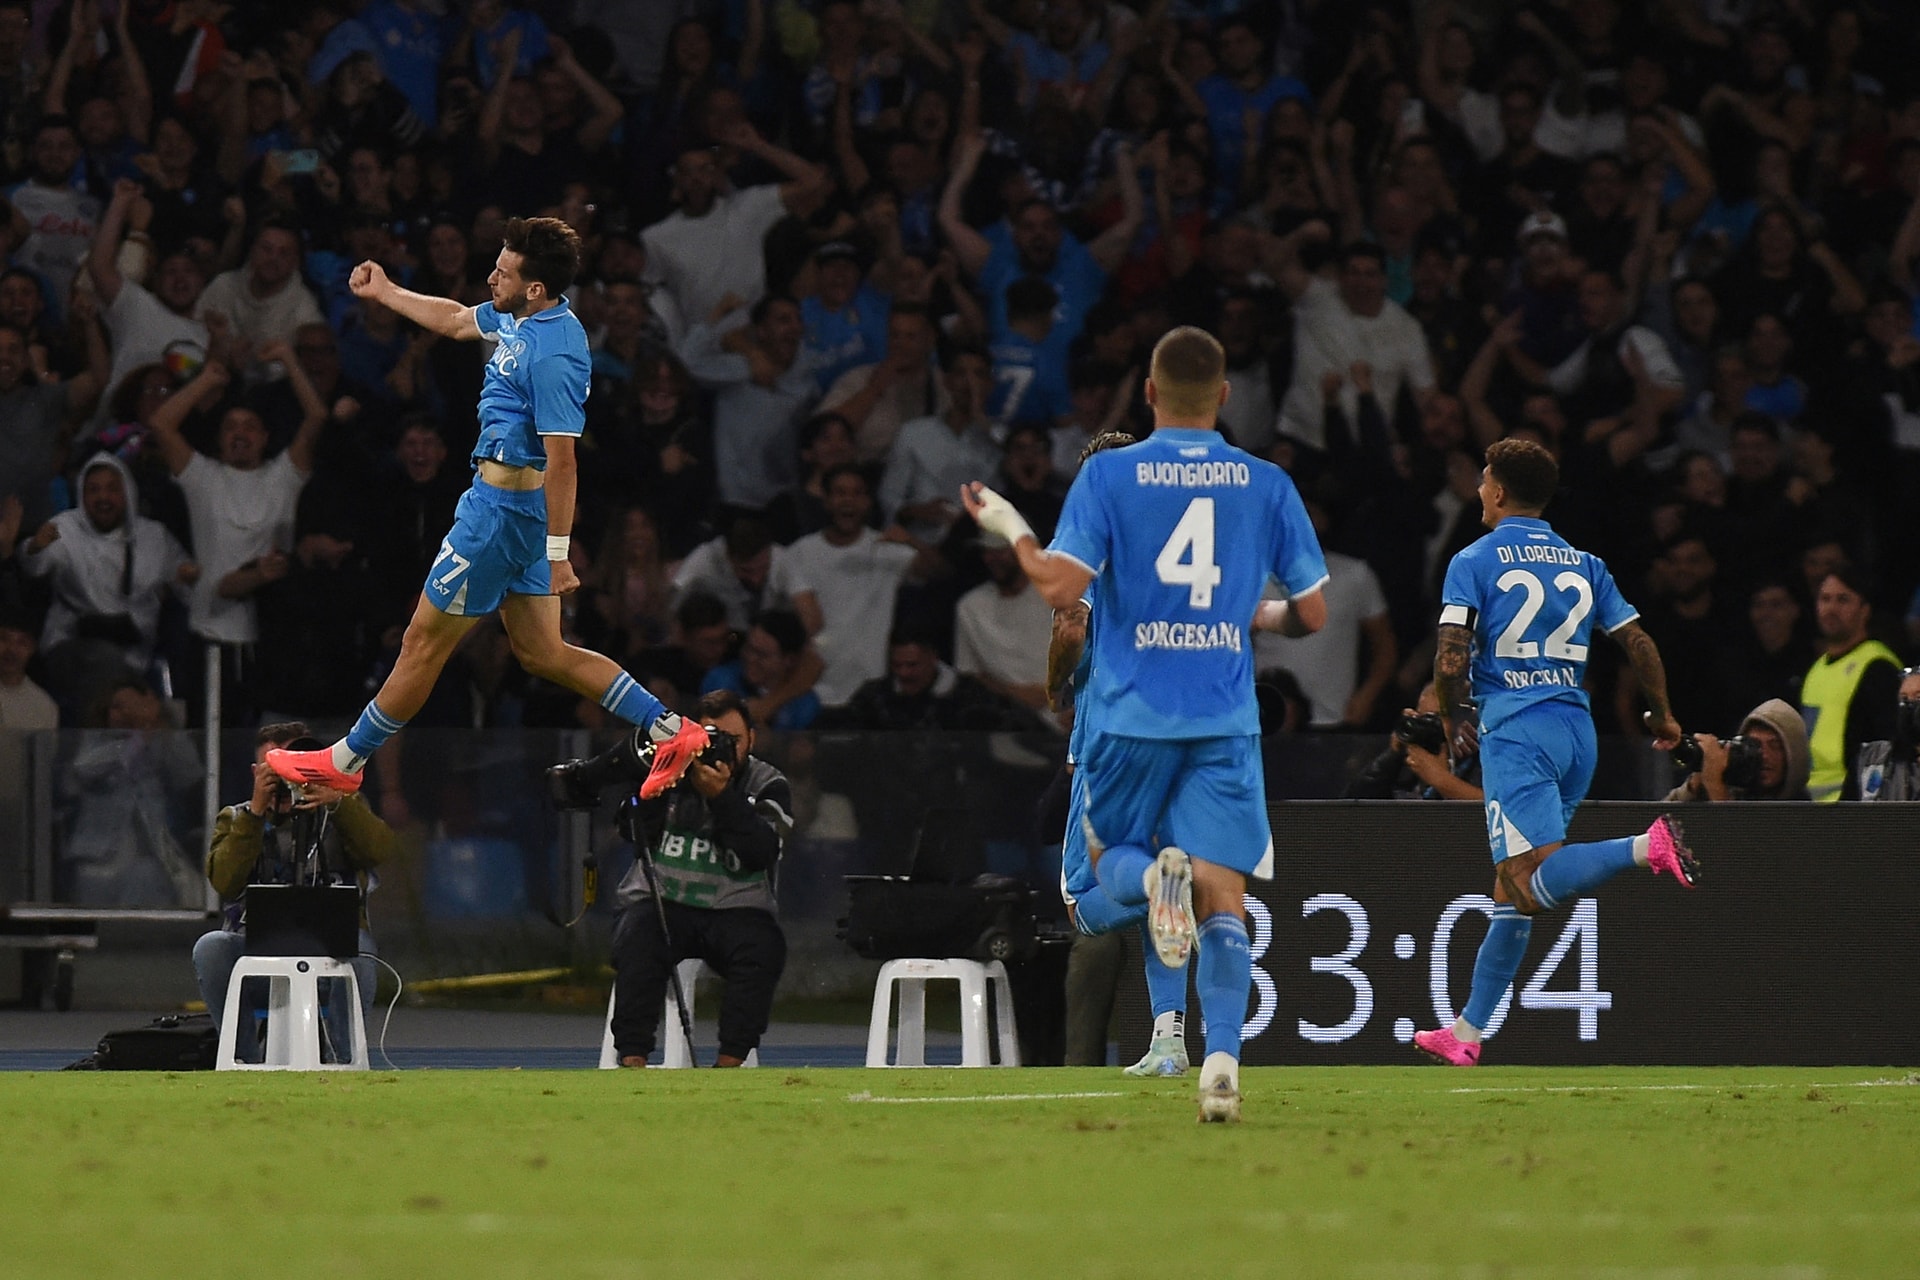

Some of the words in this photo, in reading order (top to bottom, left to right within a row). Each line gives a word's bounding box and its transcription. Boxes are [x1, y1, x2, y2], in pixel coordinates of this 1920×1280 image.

[998, 366, 1034, 420] 7
[1136, 462, 1250, 486] BUONGIORNO
[1155, 497, 1222, 609] 4
[1497, 545, 1513, 564] DI
[1516, 545, 1581, 566] LORENZO
[432, 578, 450, 596] EA7
[1495, 569, 1594, 662] 22
[1135, 620, 1241, 652] SORGESANA
